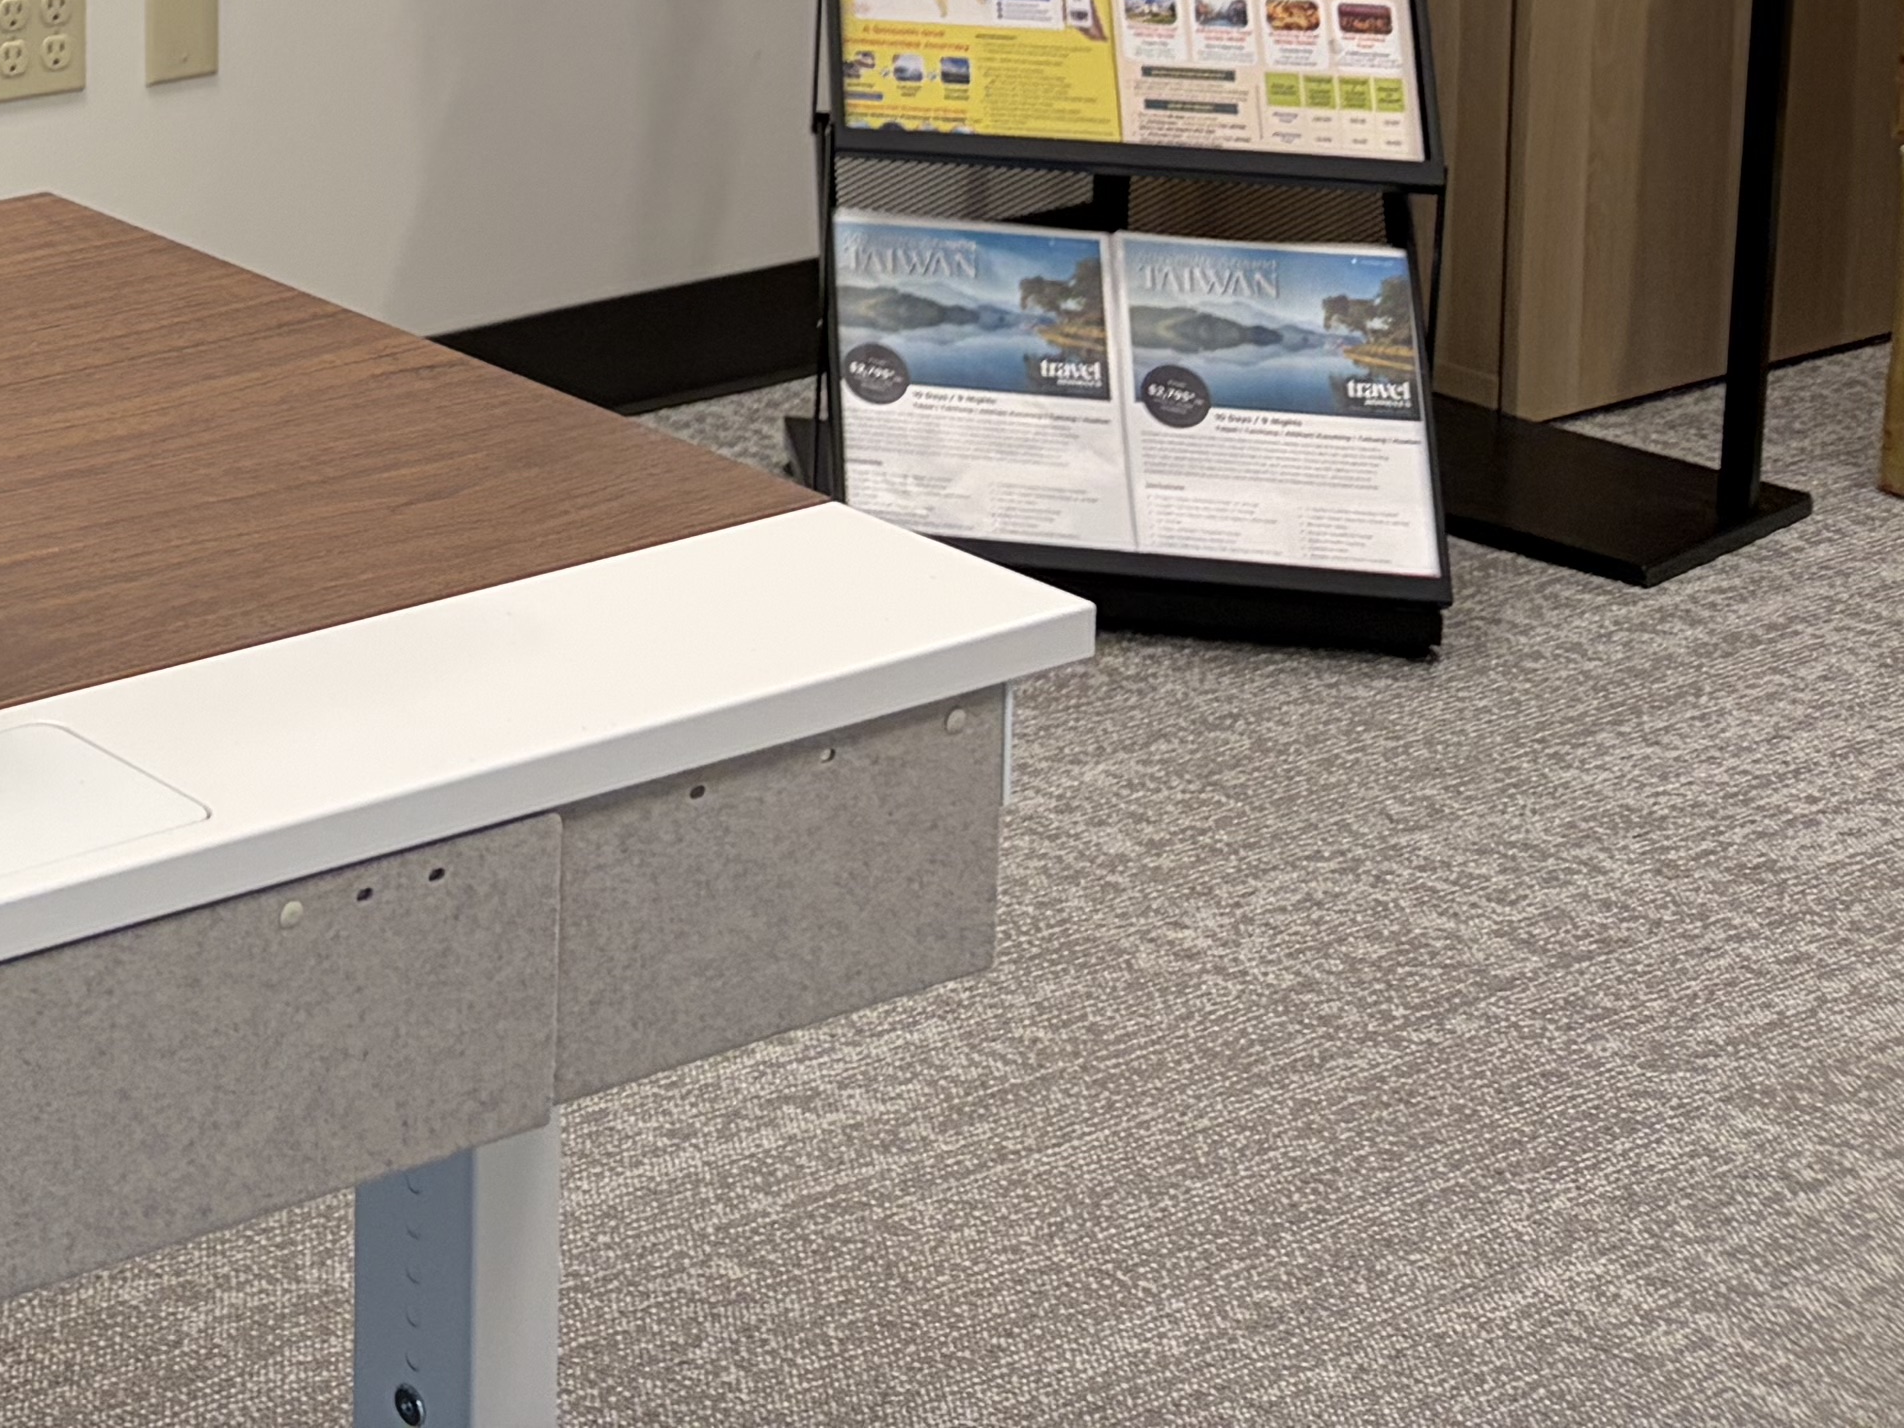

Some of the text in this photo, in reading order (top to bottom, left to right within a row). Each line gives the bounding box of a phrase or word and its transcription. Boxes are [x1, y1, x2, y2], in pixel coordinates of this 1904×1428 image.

[844, 243, 976, 278] TAIWAN
[1139, 264, 1280, 298] TAIWAN
[1040, 359, 1101, 380] travel
[1347, 378, 1410, 400] travel
